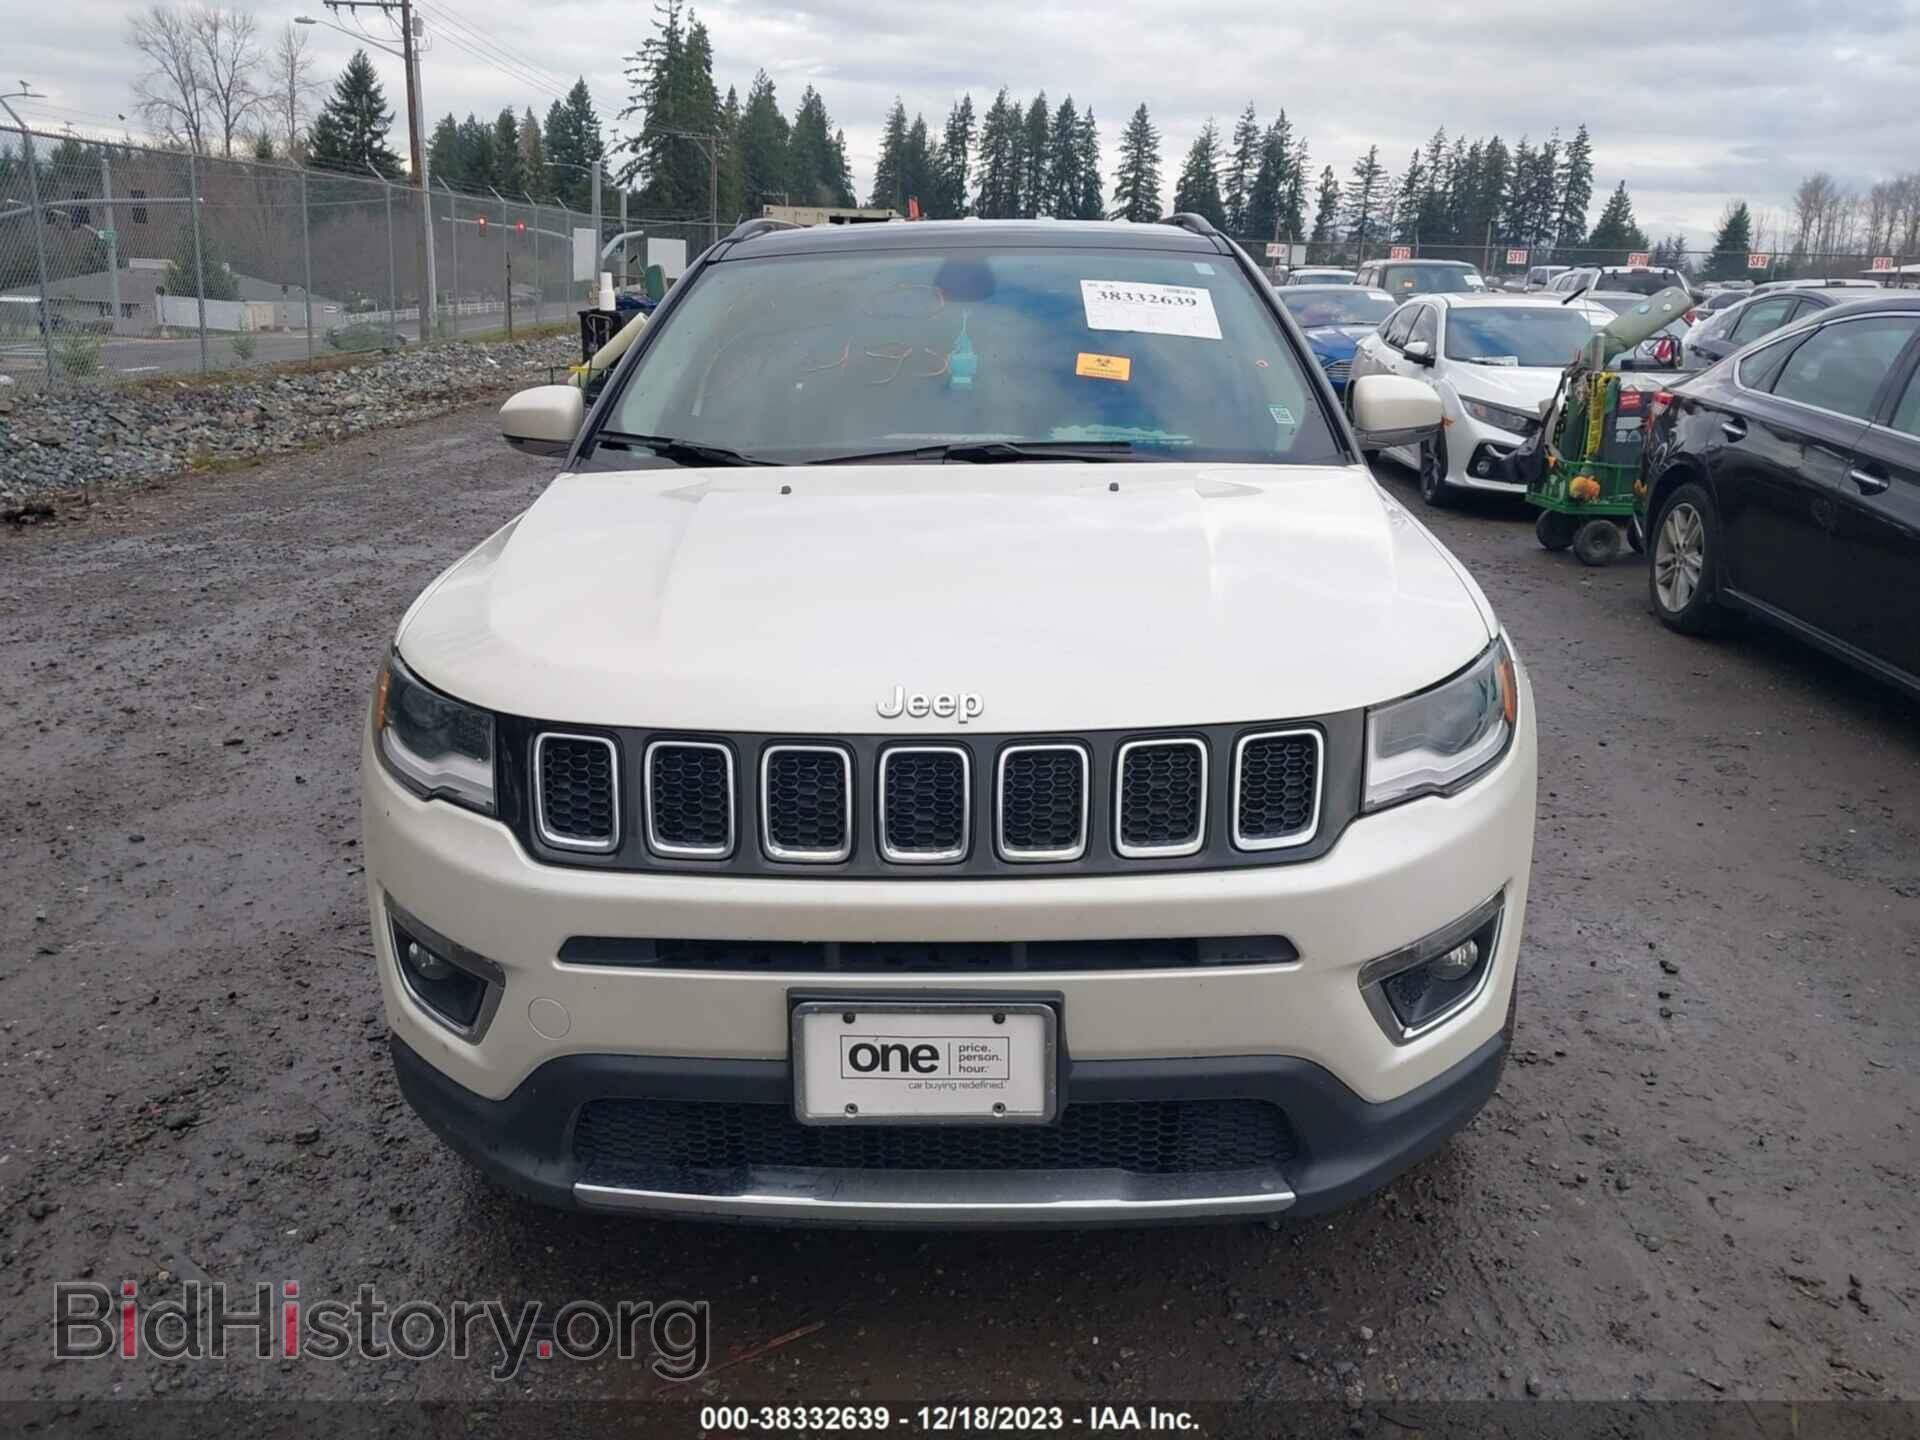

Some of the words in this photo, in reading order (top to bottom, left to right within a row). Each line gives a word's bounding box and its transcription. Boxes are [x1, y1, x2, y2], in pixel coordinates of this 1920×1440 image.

[1509, 252, 1526, 262] SF11
[1750, 255, 1766, 266] SF9
[1096, 290, 1197, 307] 38332639
[876, 684, 984, 724] Jeep
[958, 1043, 991, 1053] price.
[848, 1042, 940, 1074] one
[958, 1054, 1002, 1063] person.
[925, 1080, 957, 1091] buying
[959, 1080, 1006, 1089] redefined.
